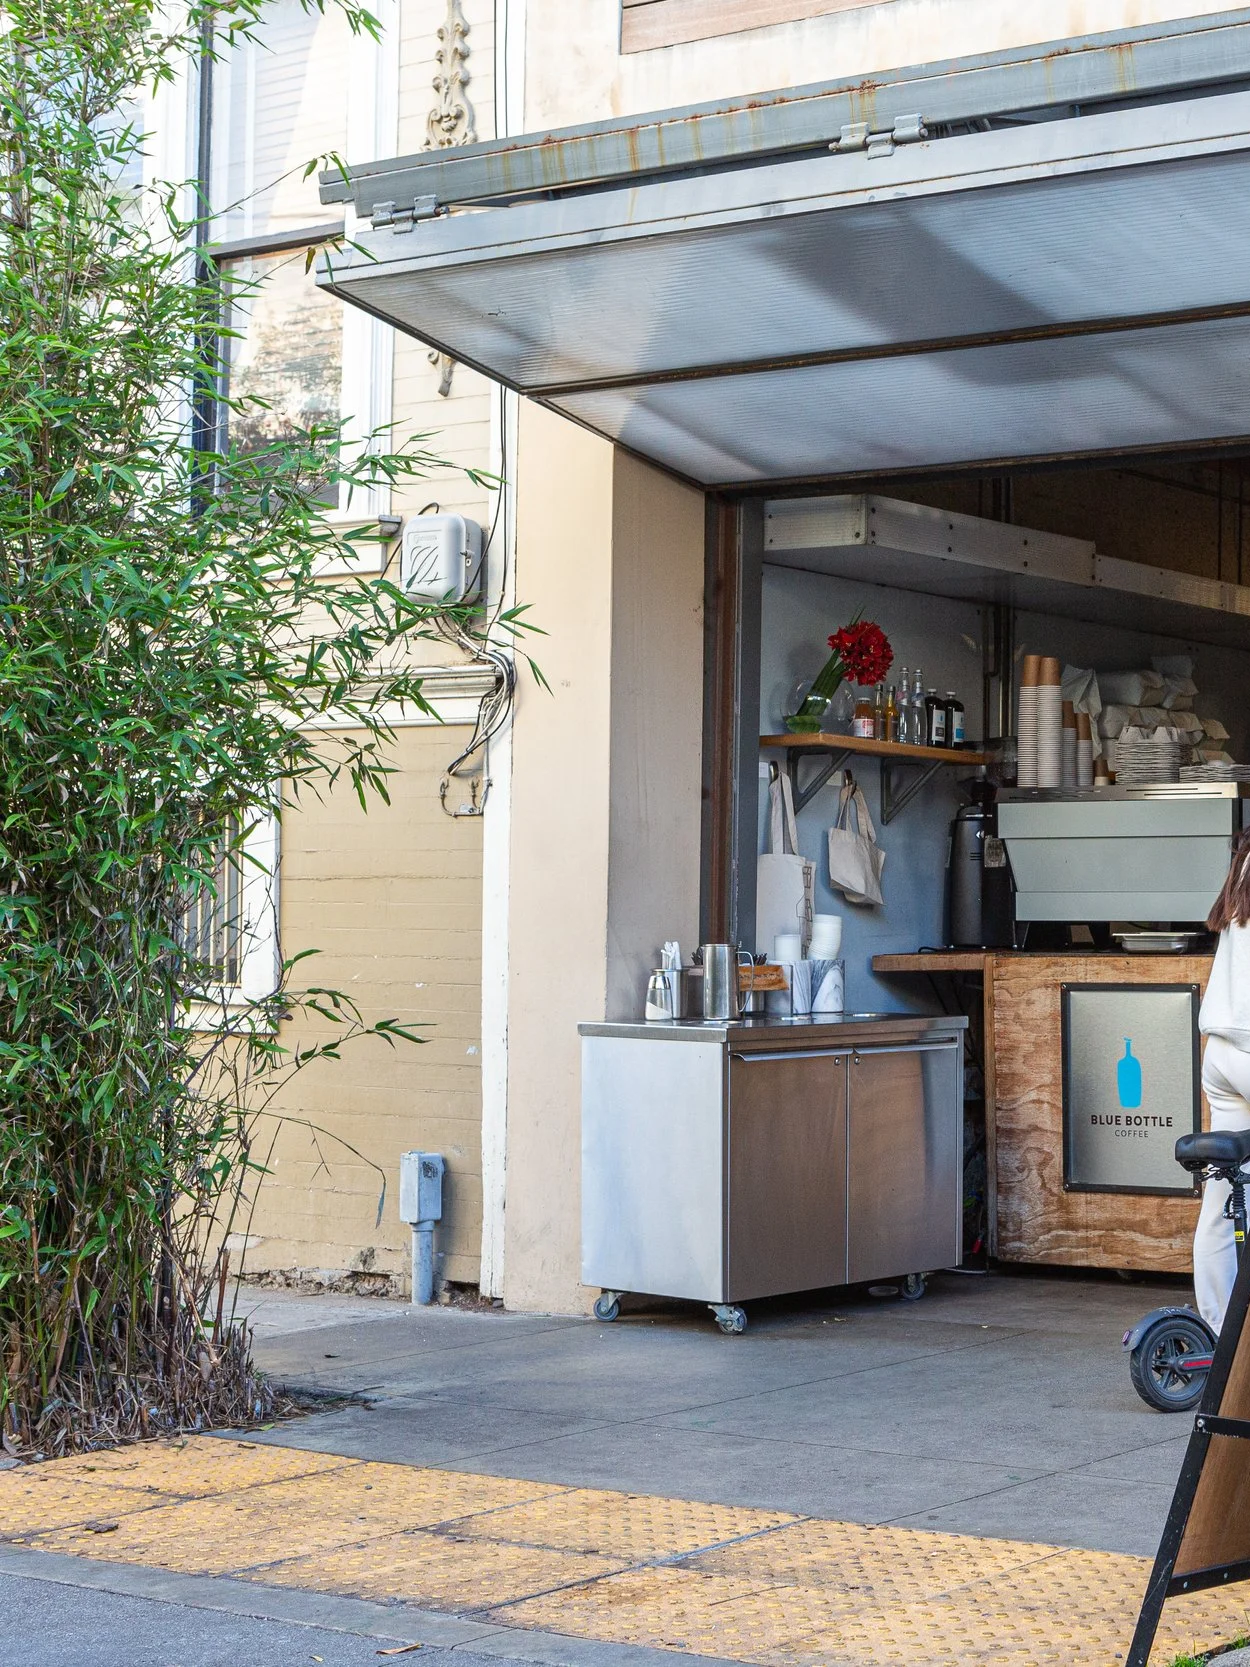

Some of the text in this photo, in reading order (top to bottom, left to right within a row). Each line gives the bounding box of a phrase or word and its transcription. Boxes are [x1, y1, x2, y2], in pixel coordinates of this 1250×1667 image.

[1091, 1115, 1173, 1127] BLUE BOTTLE
[1114, 1129, 1149, 1138] COFFEE
